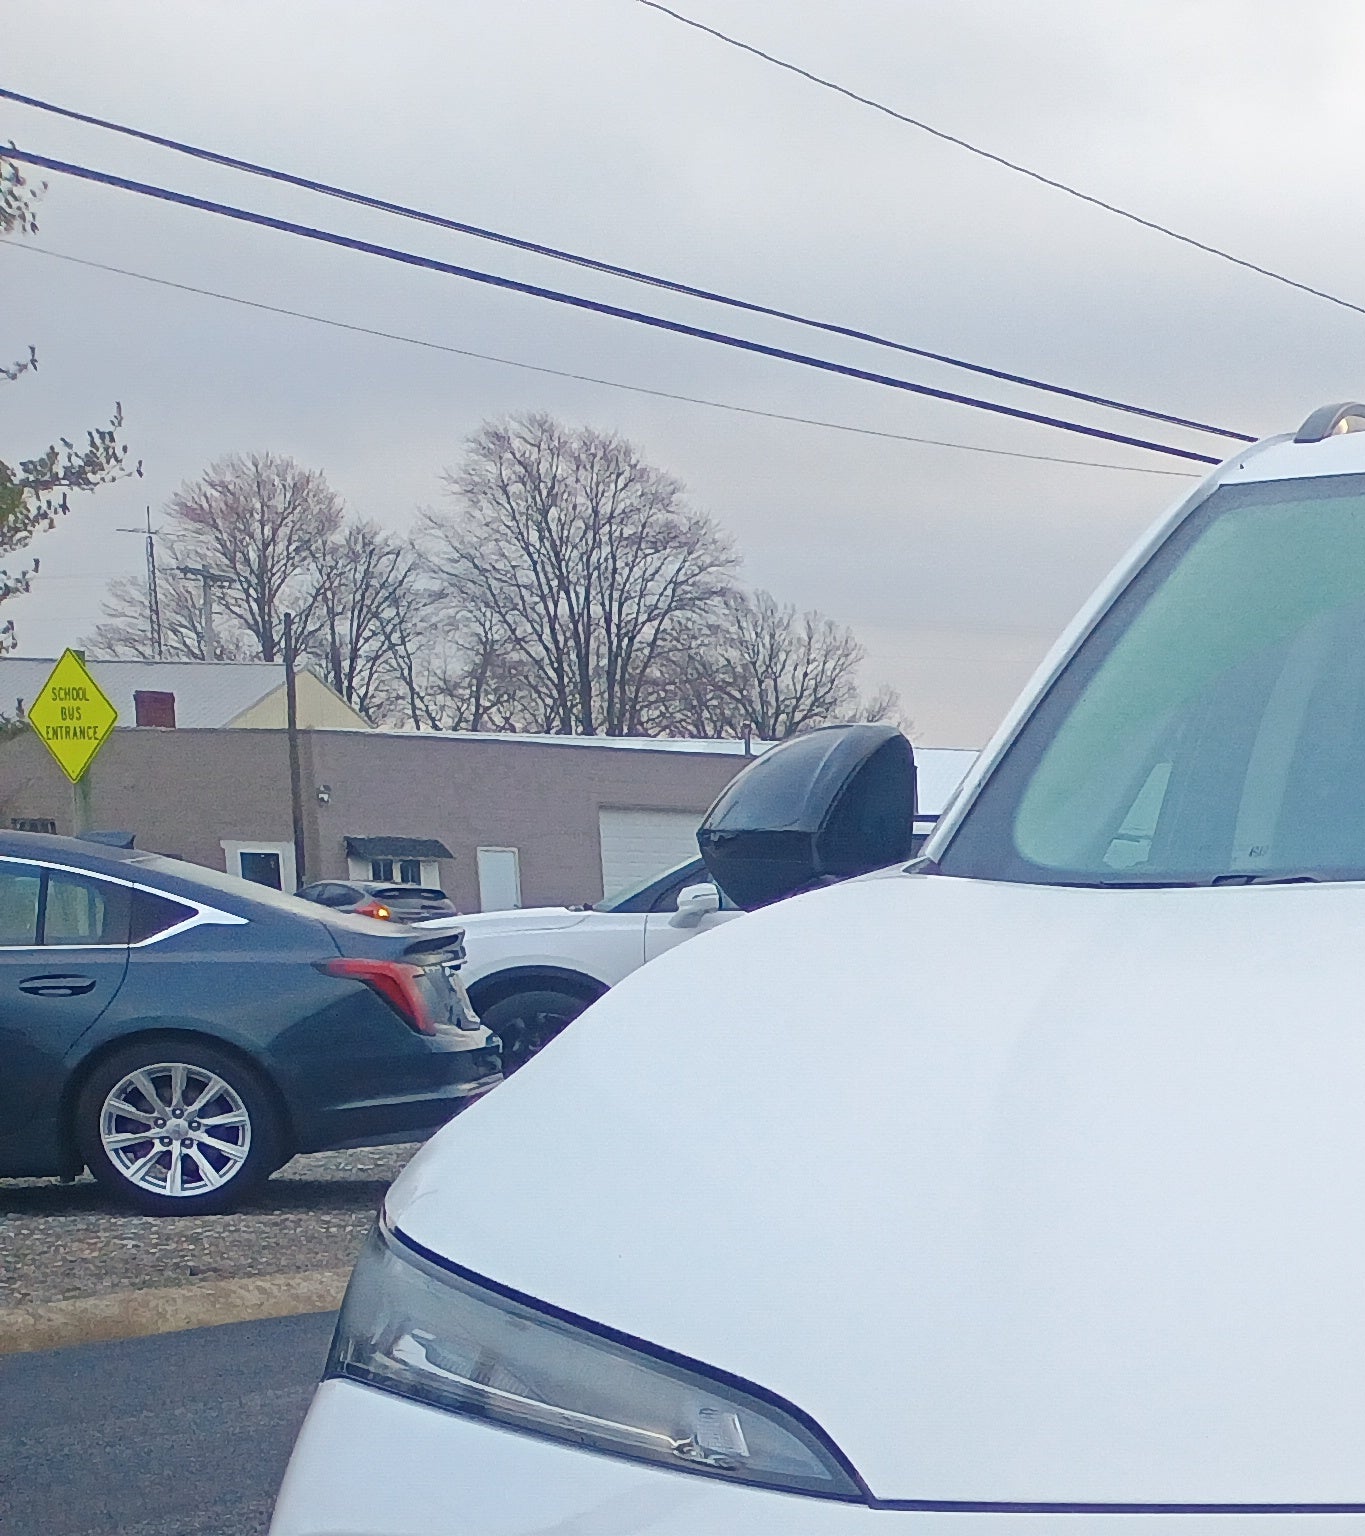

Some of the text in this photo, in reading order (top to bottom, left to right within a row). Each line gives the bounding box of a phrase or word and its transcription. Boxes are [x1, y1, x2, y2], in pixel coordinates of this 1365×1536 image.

[51, 686, 90, 702] SCHOOL
[60, 706, 82, 721] BUS
[46, 725, 100, 741] ENTRANCE
